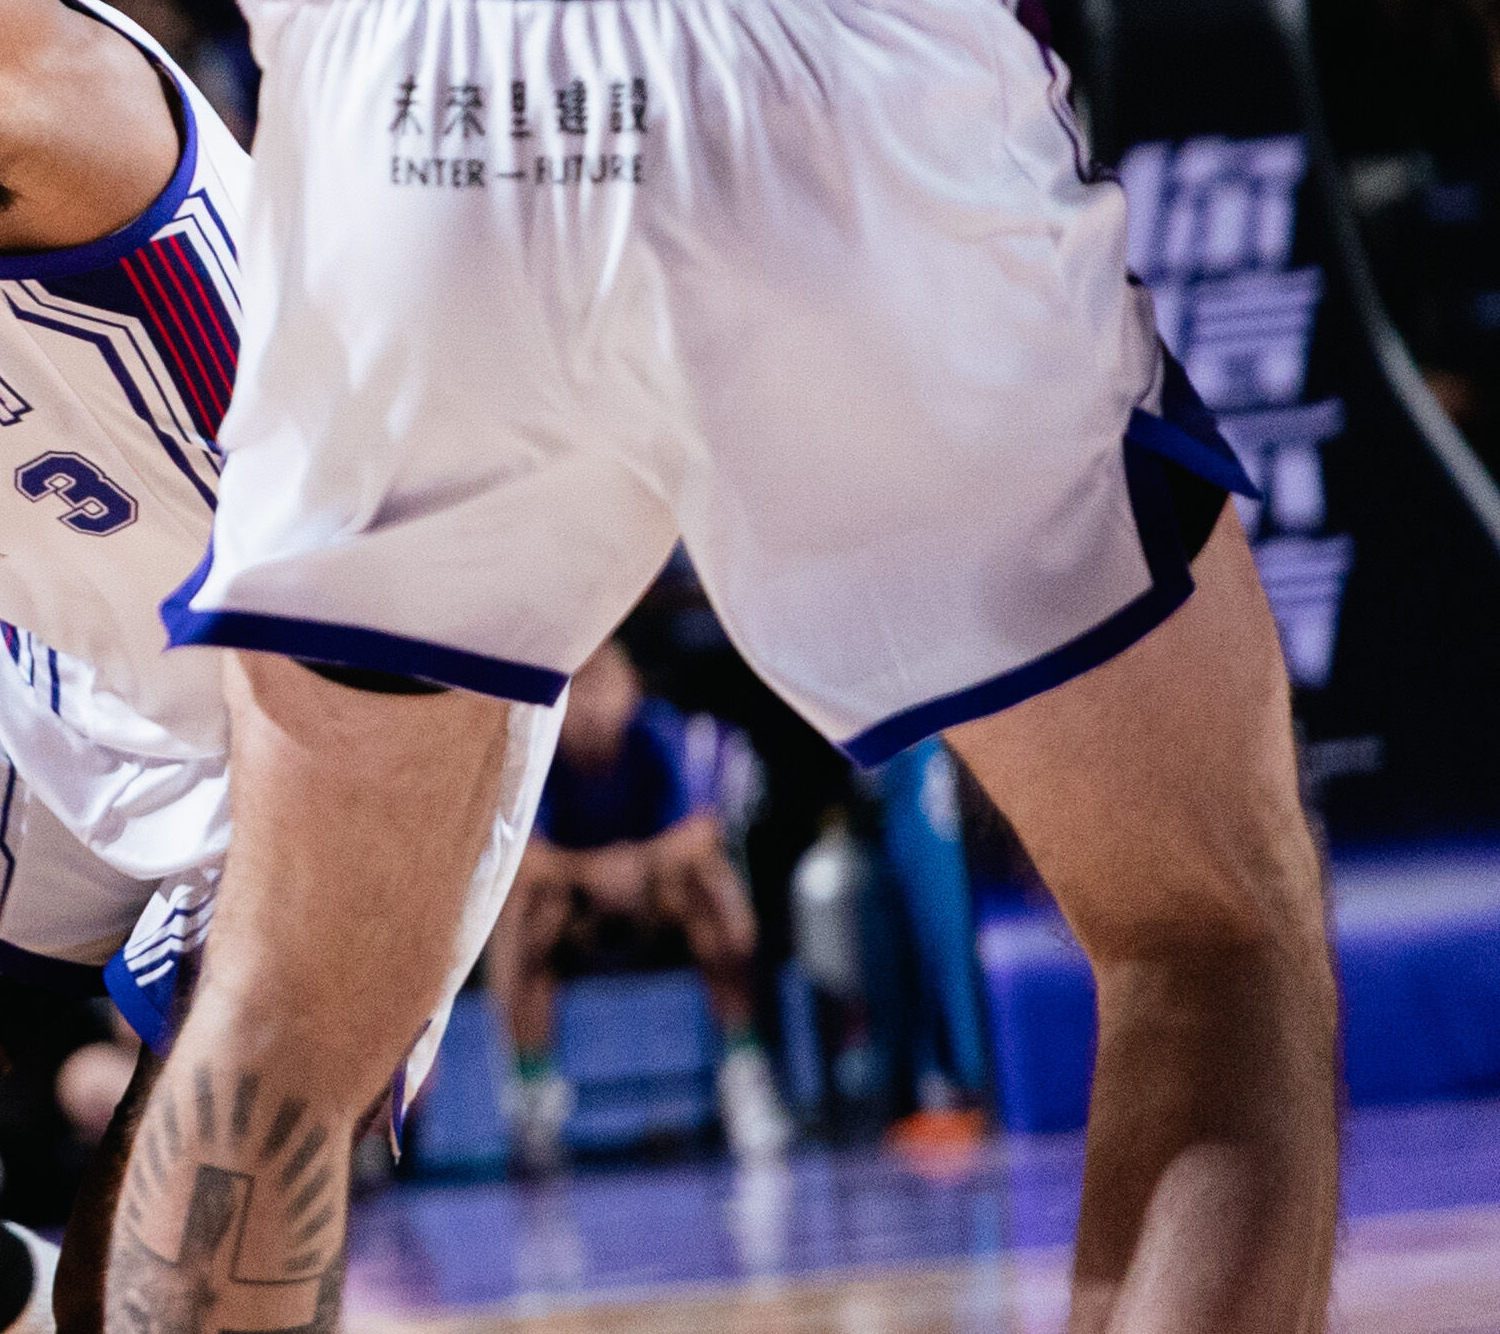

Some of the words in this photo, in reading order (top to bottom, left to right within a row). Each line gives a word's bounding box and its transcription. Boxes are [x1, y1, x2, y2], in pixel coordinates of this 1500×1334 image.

[390, 155, 486, 188] ENTER
[534, 153, 646, 186] FUTURE
[14, 451, 139, 537] 3
